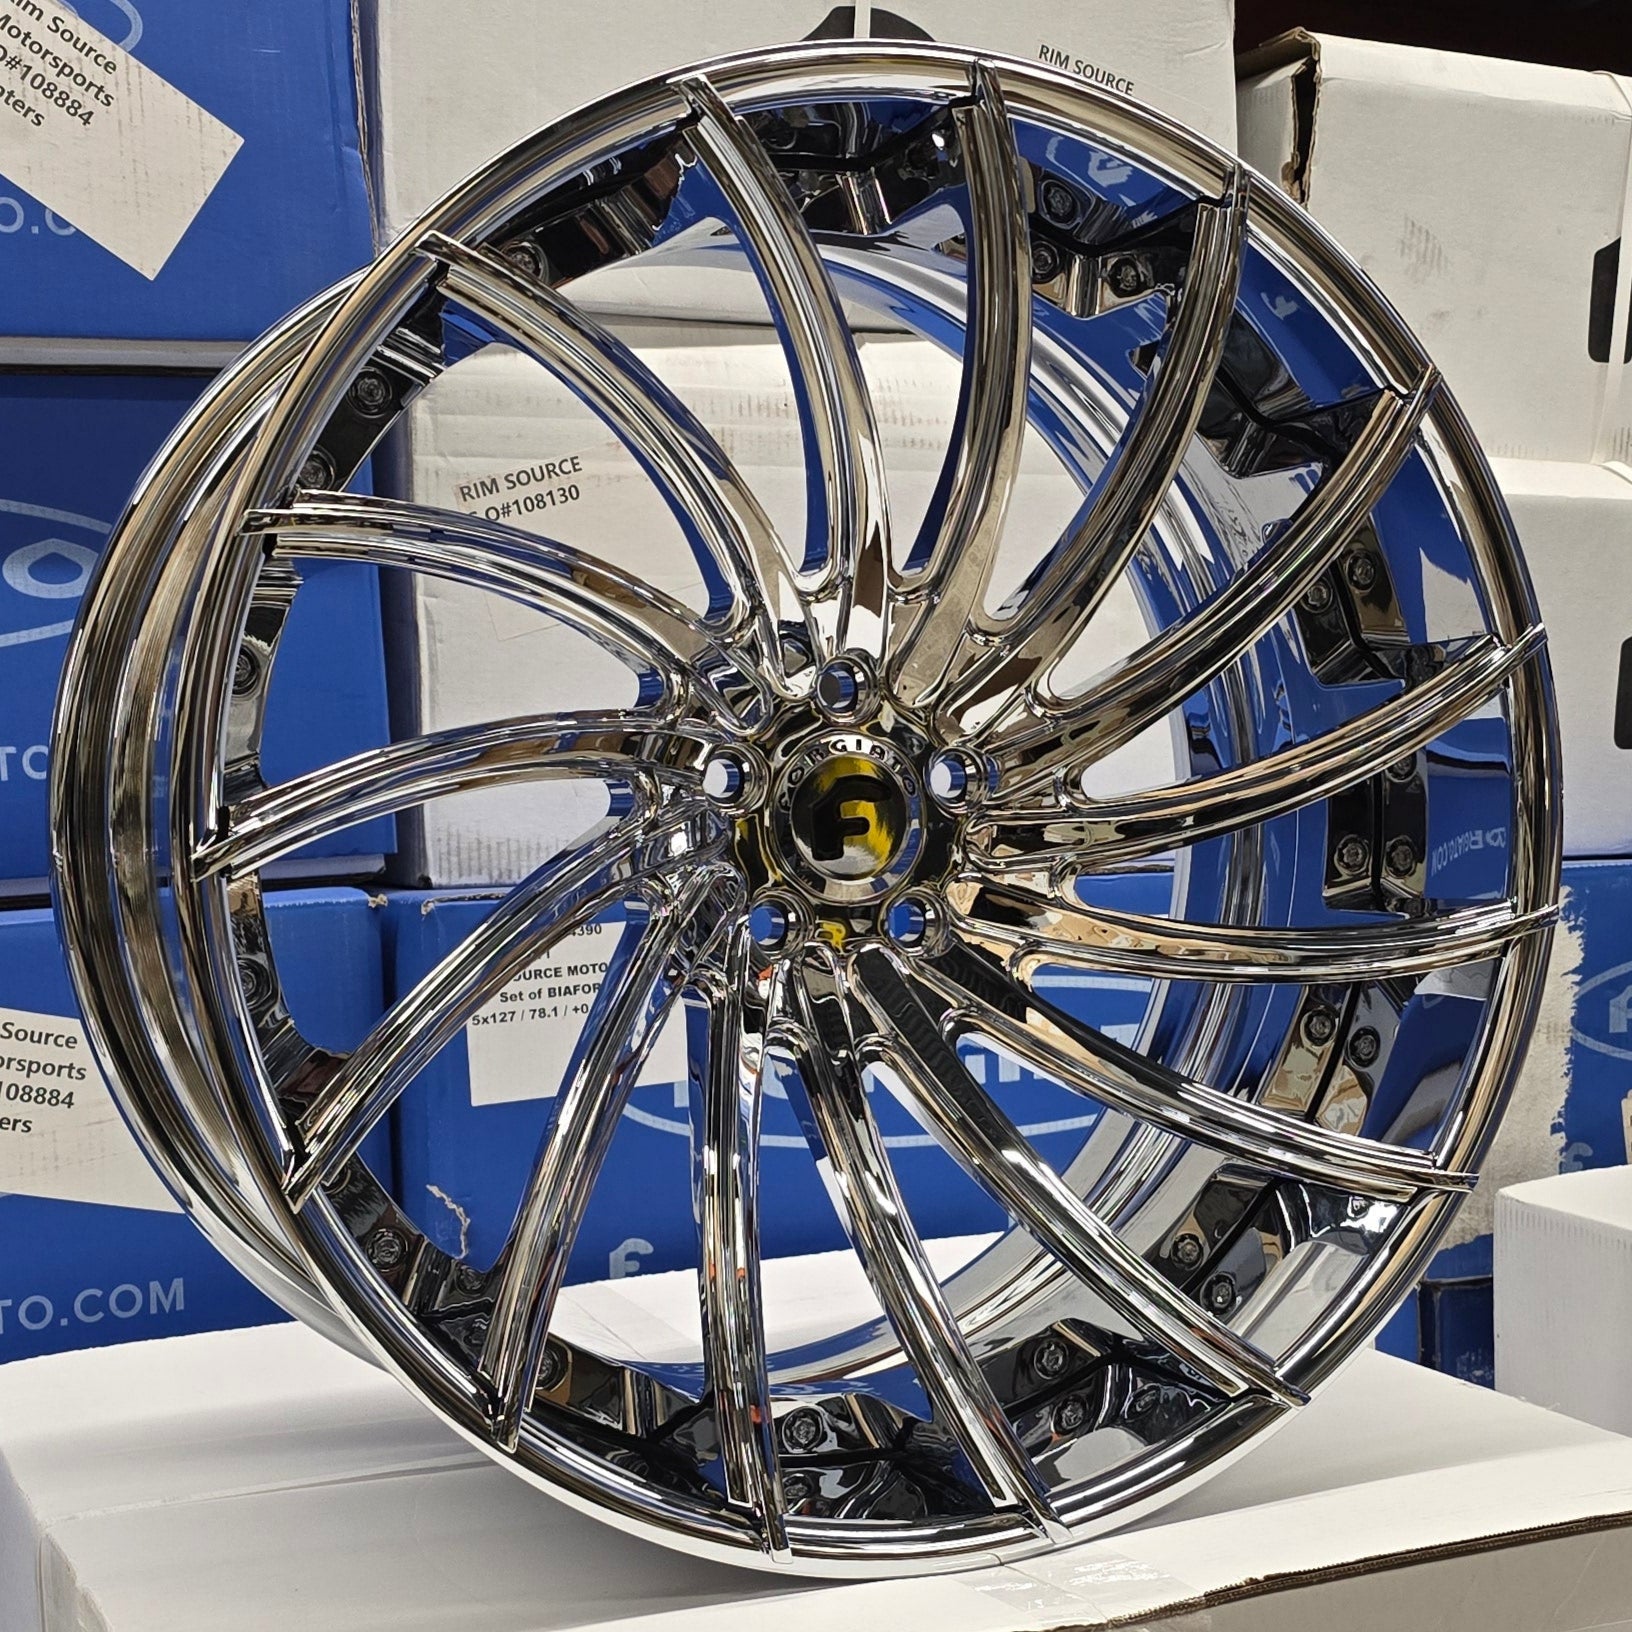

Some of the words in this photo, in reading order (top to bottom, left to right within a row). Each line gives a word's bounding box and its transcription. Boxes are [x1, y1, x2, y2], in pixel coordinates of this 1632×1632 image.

[10, 0, 44, 21] im
[47, 16, 117, 75] Source
[1039, 44, 1070, 70] RIM
[1073, 59, 1135, 96] SOURCE
[460, 477, 500, 502] RIM
[504, 456, 582, 490] SOURCE
[500, 990, 523, 1003] Set
[529, 987, 542, 1000] of
[471, 1011, 516, 1026] 5x127
[529, 1006, 558, 1020] 78.1
[0, 1021, 78, 1049] Source
